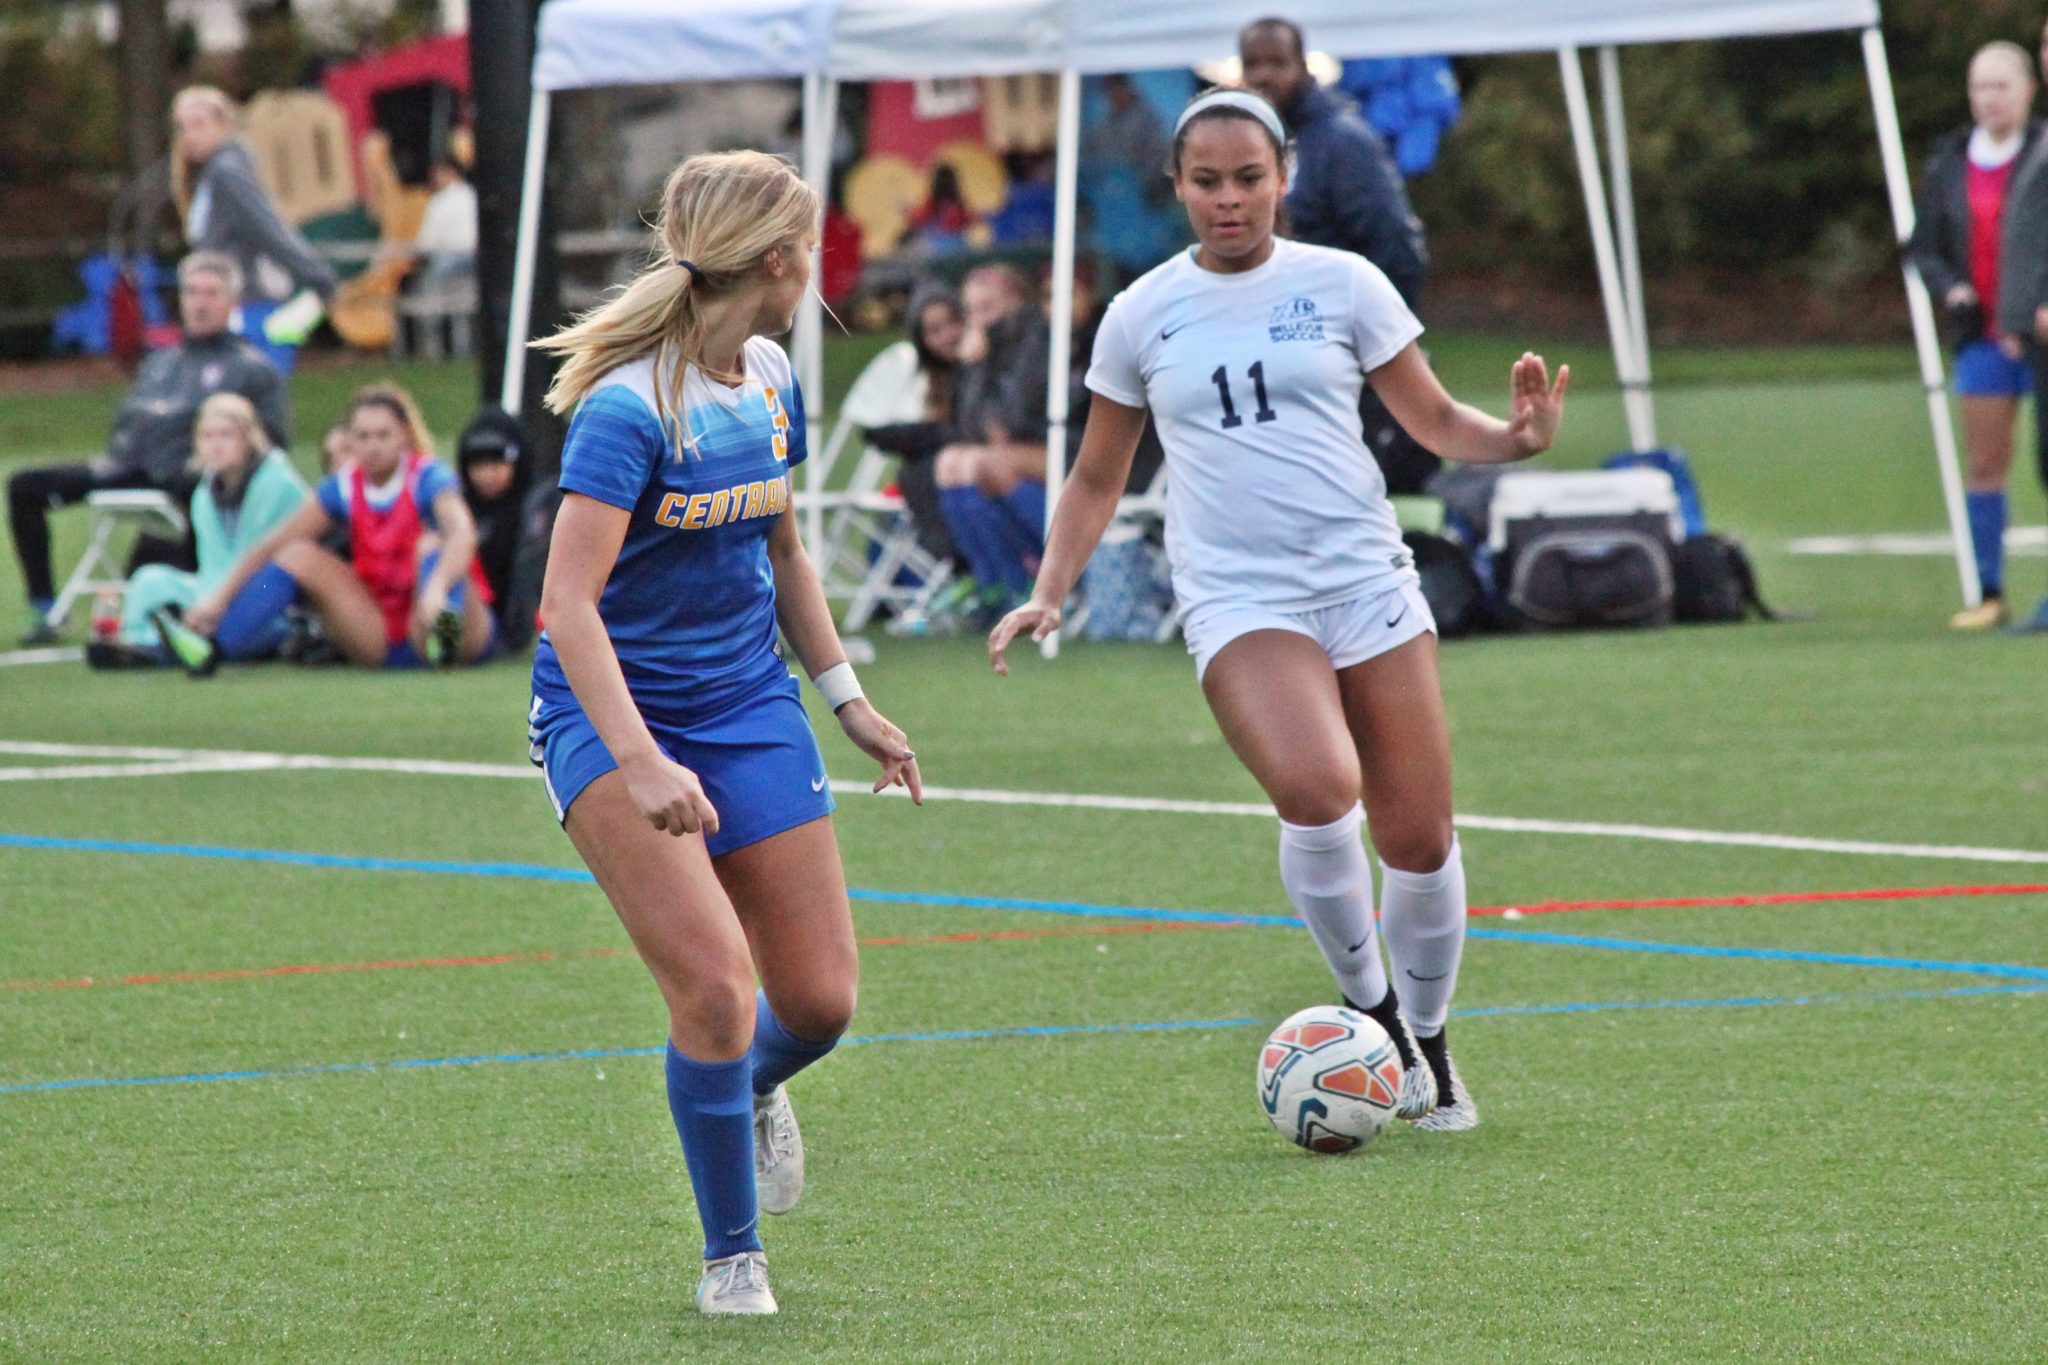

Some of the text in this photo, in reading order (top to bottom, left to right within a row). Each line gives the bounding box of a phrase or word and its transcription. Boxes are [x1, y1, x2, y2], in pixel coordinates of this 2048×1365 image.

[1269, 323, 1324, 335] BELLEVUE
[1270, 332, 1326, 343] SOCCER
[1211, 360, 1277, 429] 11
[763, 386, 789, 462] 3
[655, 475, 788, 530] CENTRAL
